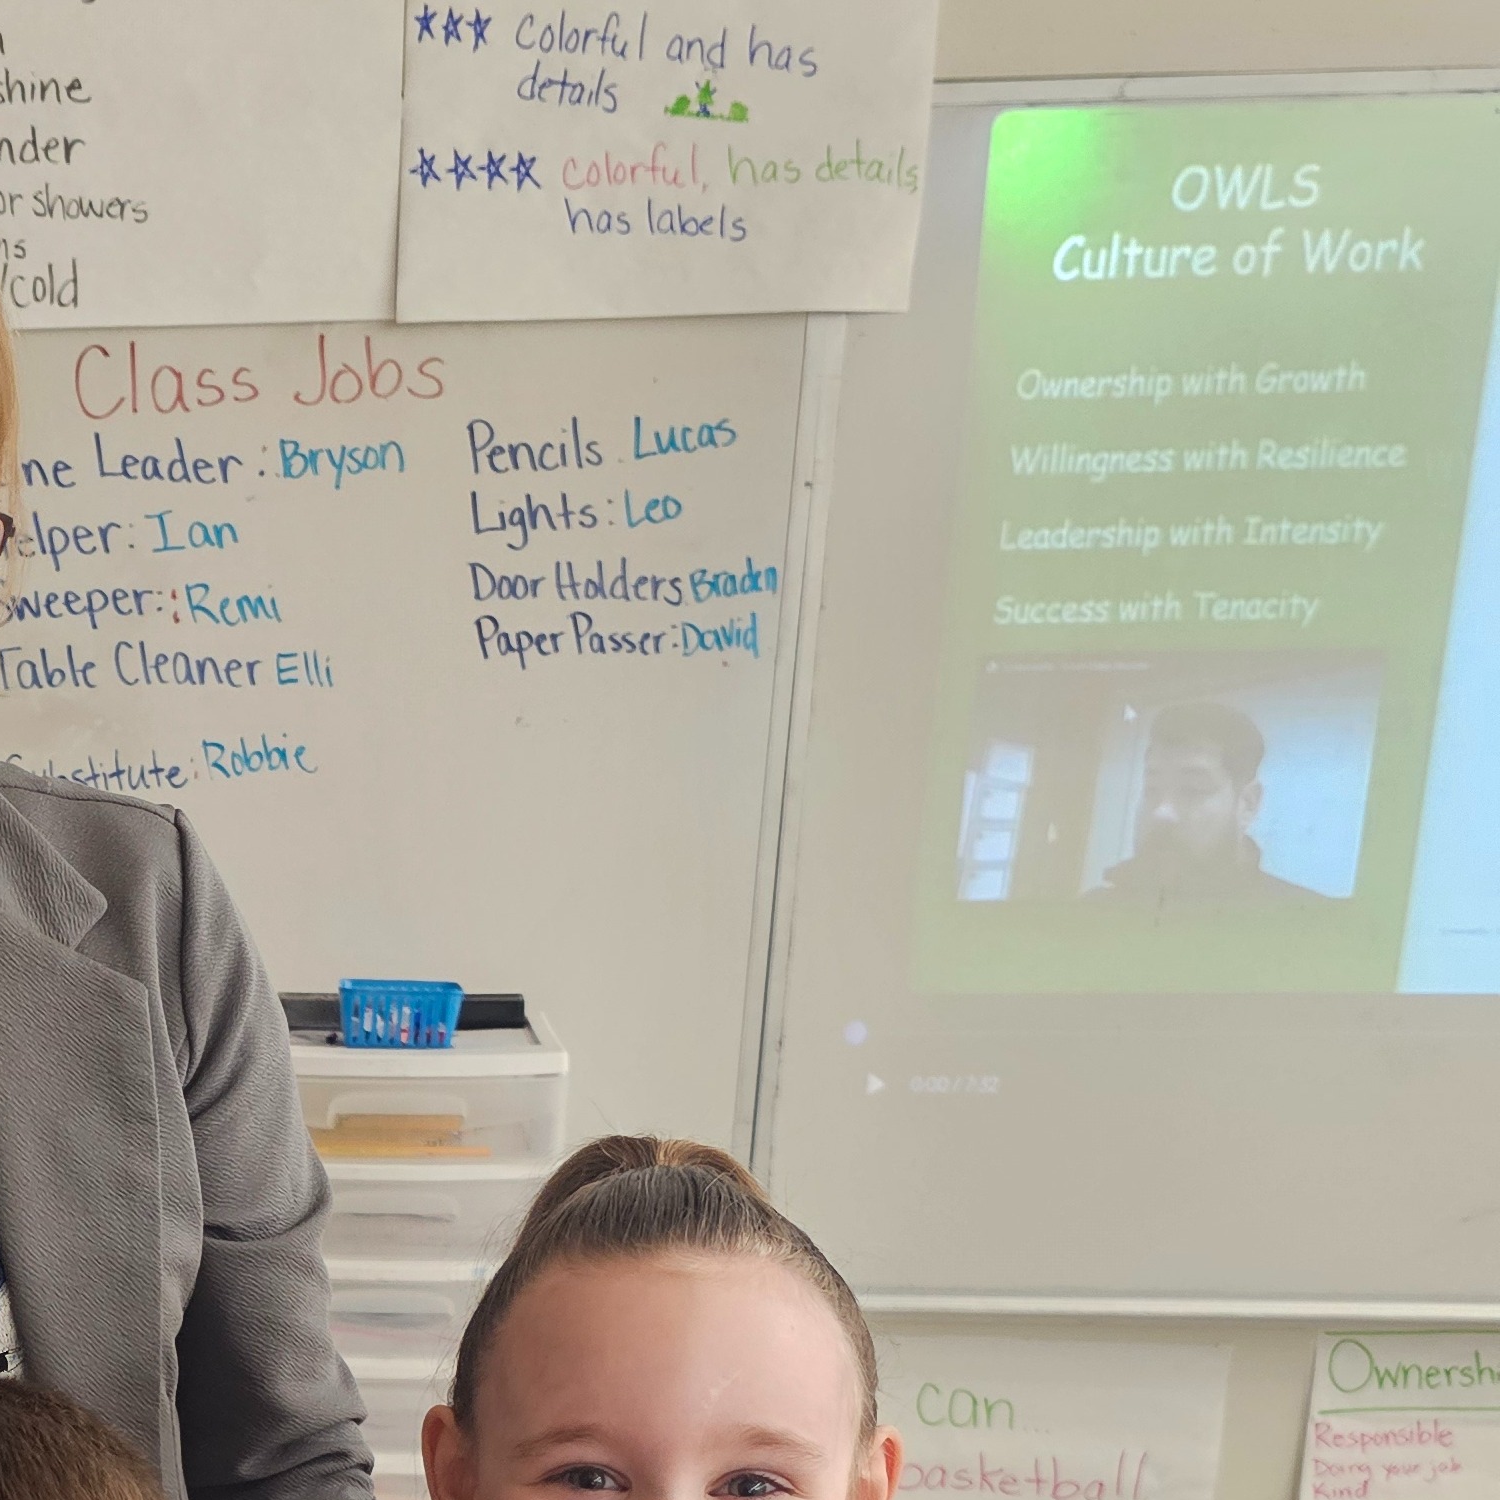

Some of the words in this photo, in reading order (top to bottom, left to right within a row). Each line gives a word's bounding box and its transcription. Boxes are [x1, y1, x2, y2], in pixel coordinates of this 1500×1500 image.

[666, 26, 727, 69] and
[749, 24, 818, 79] has
[517, 60, 619, 114] details
[727, 145, 802, 186] has
[1171, 163, 1323, 212] OWLS
[32, 182, 149, 224] showers
[564, 197, 630, 236] has
[647, 197, 748, 243] labels
[1052, 230, 1218, 282] Culture
[1232, 227, 1286, 277] of
[1302, 225, 1427, 274] Work
[74, 340, 260, 420] Class
[293, 333, 446, 406] Jobs
[1016, 365, 1172, 405] Ownership
[1182, 362, 1246, 395] with
[1254, 358, 1367, 395] Growth
[633, 415, 738, 461] Lucas
[1009, 443, 1176, 484] Willingness
[1182, 438, 1248, 473] with
[1256, 434, 1407, 471] Resilience
[279, 439, 405, 491] Bryson
[624, 488, 683, 529] Leo
[0, 511, 137, 572] elper:
[145, 509, 239, 555] Ian
[999, 518, 1161, 557] Leadership
[1170, 515, 1235, 547] with
[1241, 514, 1384, 551] Intensity
[467, 561, 547, 602] Door
[993, 593, 1111, 627] Success
[1119, 589, 1182, 623] with
[1194, 589, 1320, 628] Tenacity
[474, 614, 565, 671] Paper
[681, 611, 761, 661] David
[114, 640, 263, 689] Cleaner
[275, 650, 335, 690] Elli
[203, 734, 318, 779] Robbie
[1313, 1418, 1455, 1454] Responsible
